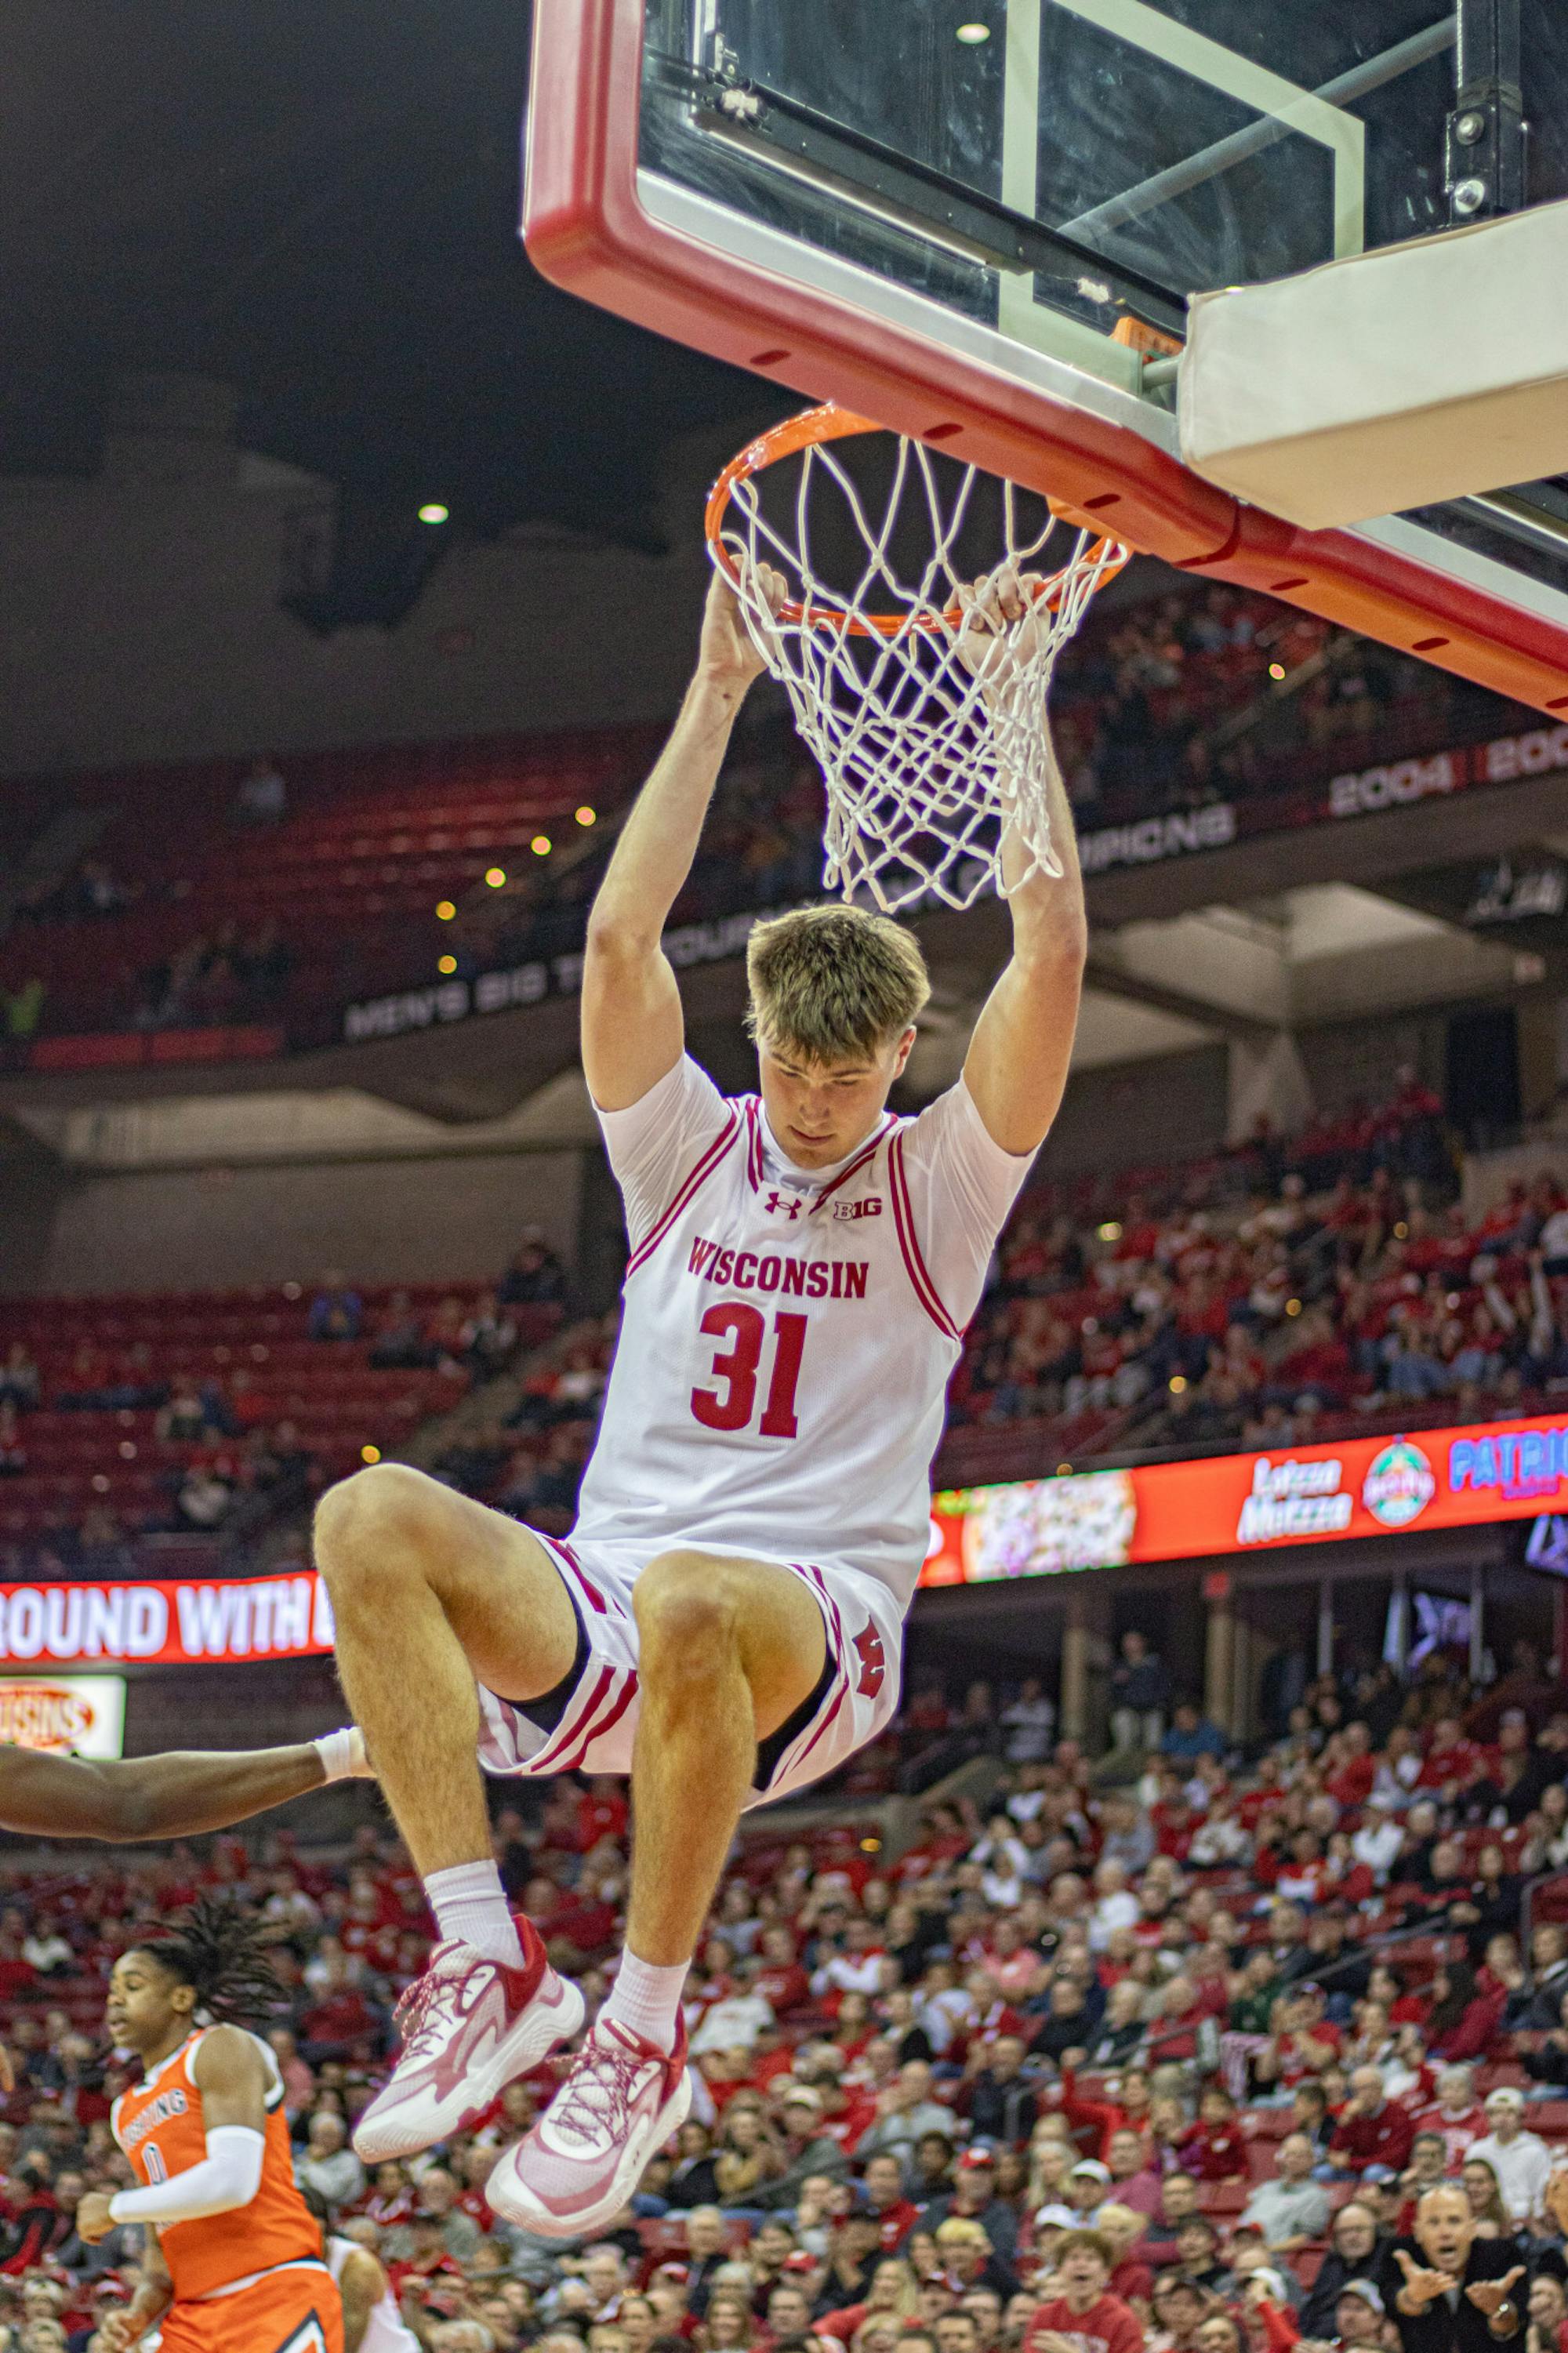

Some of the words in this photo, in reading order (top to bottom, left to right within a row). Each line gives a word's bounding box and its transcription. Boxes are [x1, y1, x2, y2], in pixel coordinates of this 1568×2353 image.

[1330, 752, 1453, 815] 2004
[688, 1236, 869, 1298] WISCONSIN
[691, 1302, 808, 1438] 31
[176, 1578, 311, 1656] WITH
